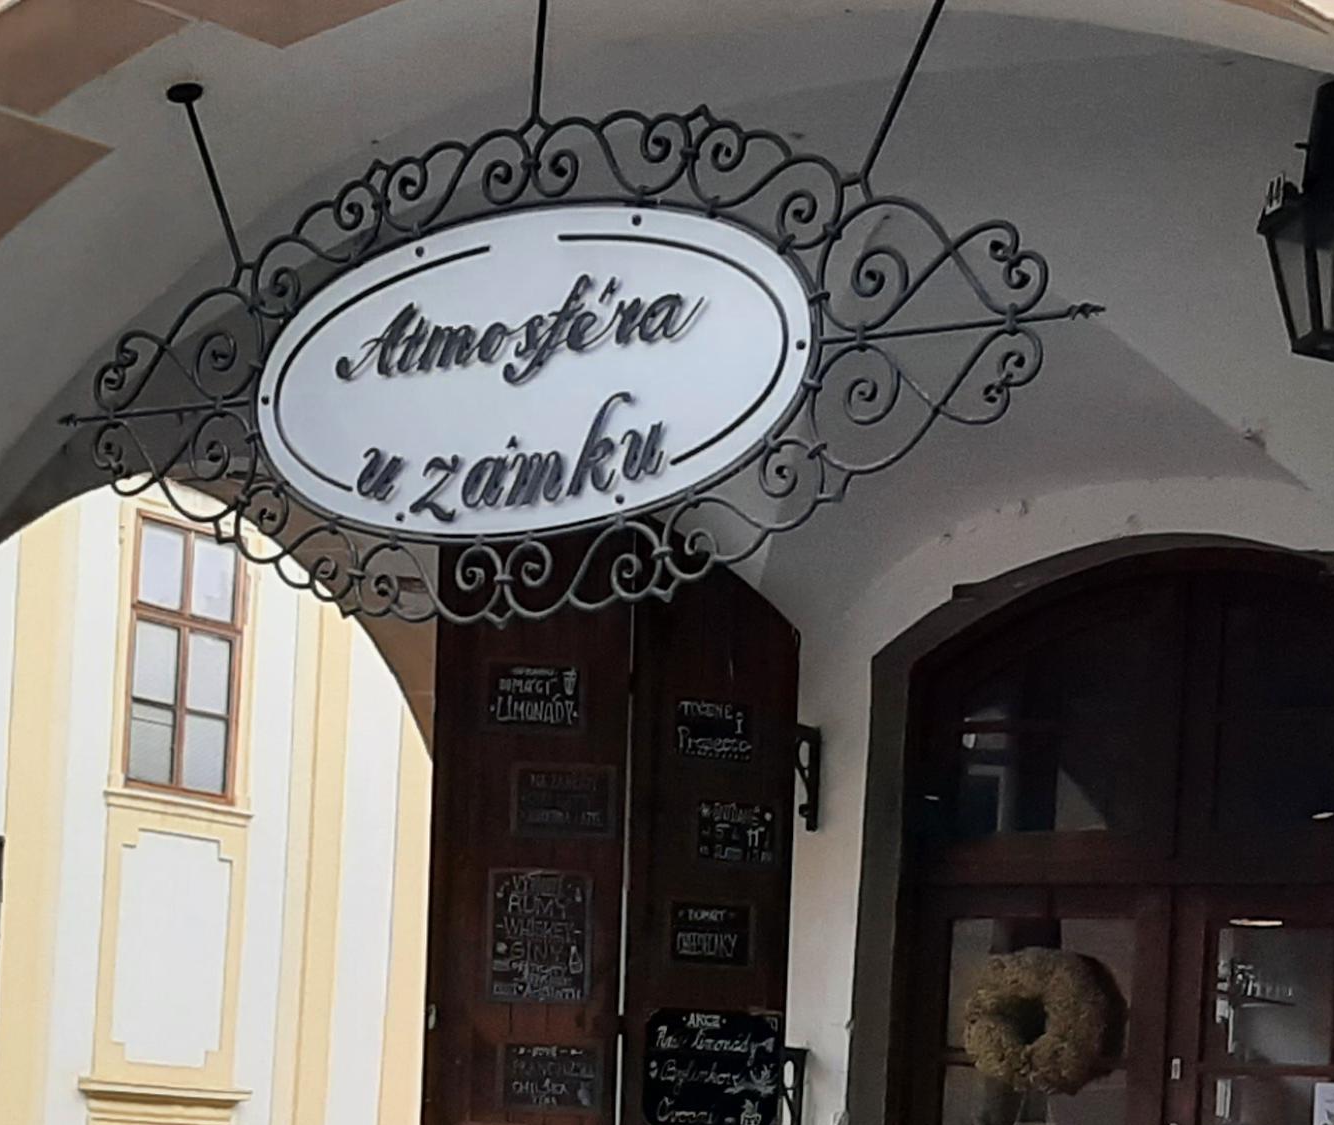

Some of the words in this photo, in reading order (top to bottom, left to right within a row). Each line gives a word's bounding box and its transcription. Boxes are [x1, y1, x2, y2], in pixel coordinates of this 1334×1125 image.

[334, 274, 706, 384] Atmosféra
[356, 446, 408, 502] u
[409, 391, 669, 523] zámku
